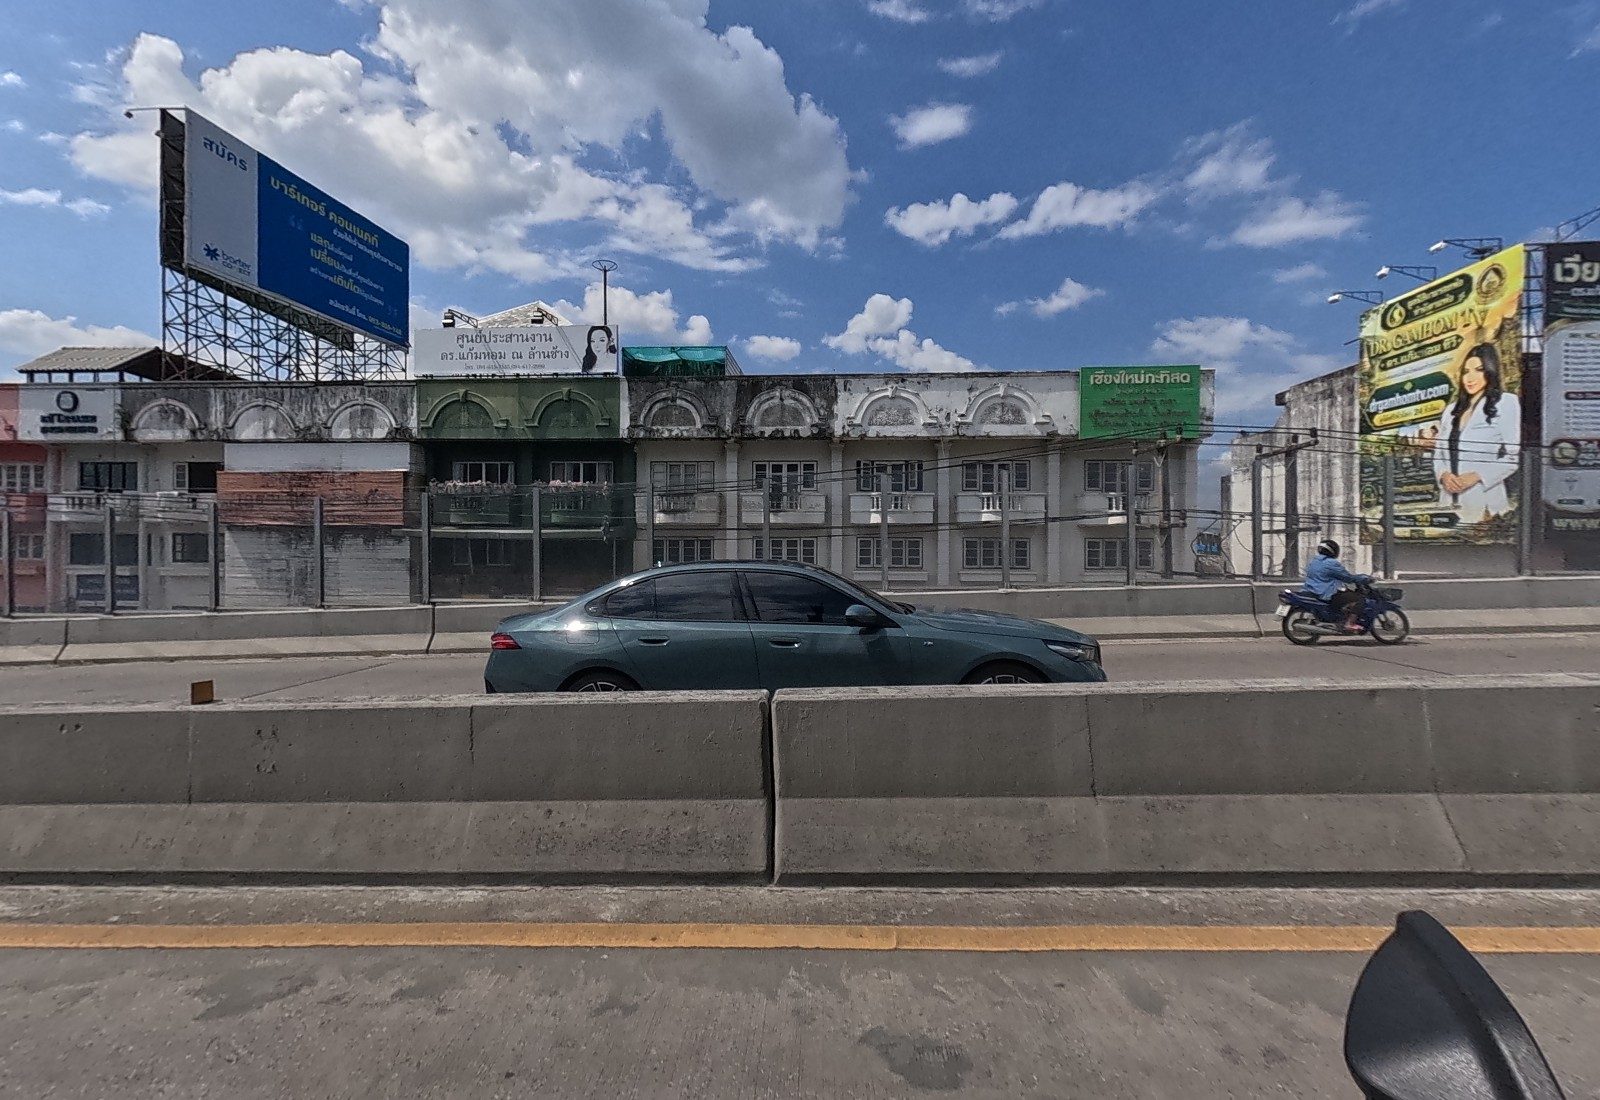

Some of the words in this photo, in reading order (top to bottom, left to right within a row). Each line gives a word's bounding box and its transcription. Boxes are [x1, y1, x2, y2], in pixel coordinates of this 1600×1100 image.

[203, 136, 248, 171] สมัคร
[456, 330, 553, 349] ศูนย์ประสานงาน
[441, 346, 506, 361] ดร.แก้มหอม
[511, 351, 524, 360] ณ
[528, 346, 570, 360] ล้านช้าง
